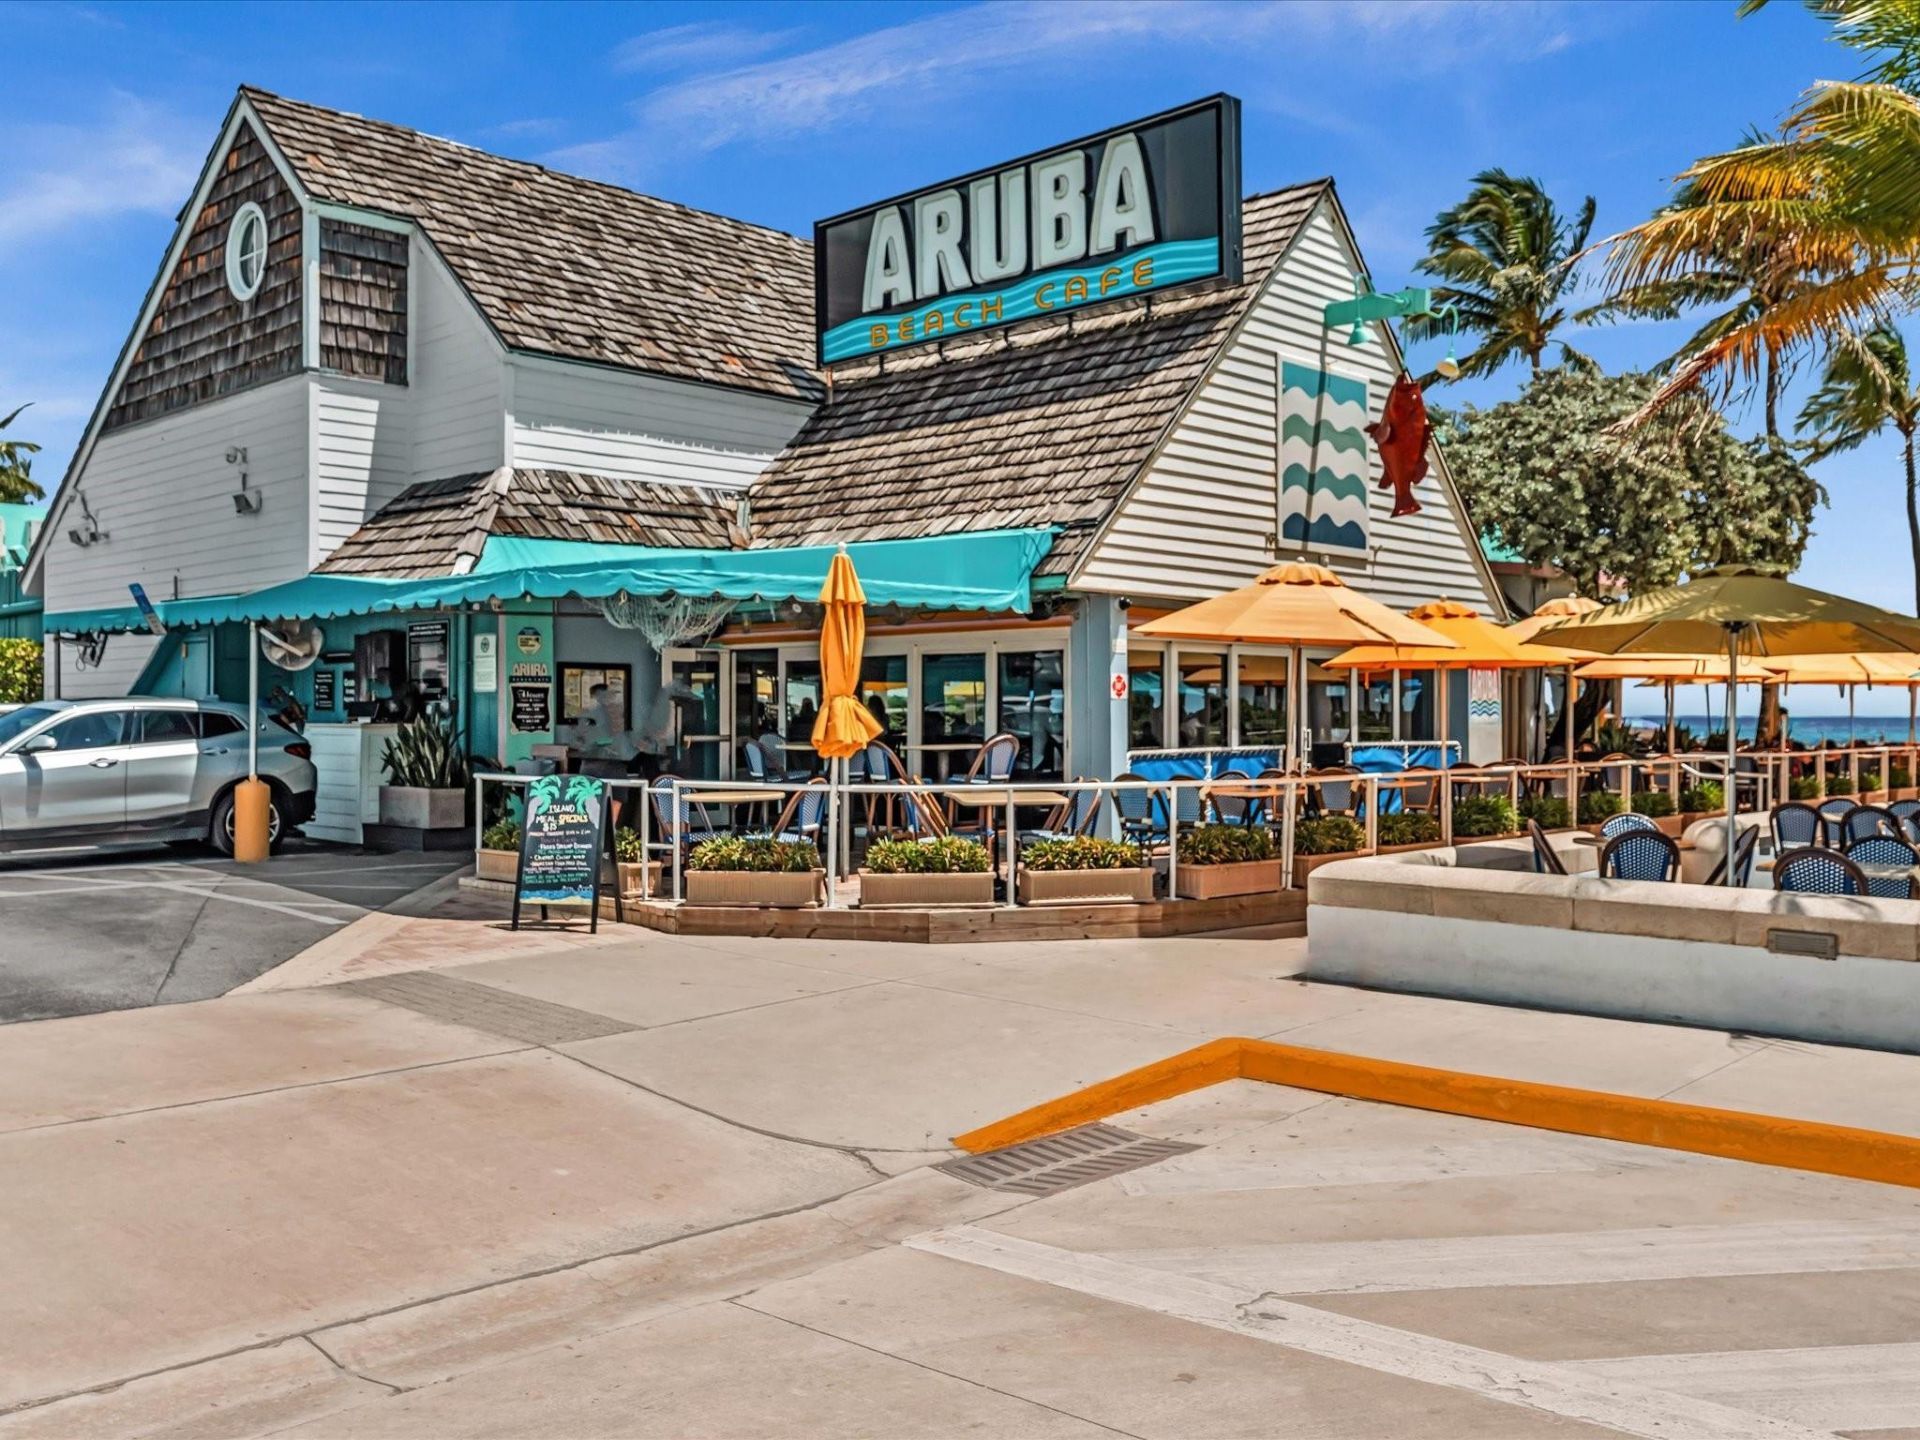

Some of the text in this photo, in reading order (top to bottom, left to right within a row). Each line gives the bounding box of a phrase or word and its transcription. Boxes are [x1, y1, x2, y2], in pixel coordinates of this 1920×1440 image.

[862, 132, 1156, 314] ARUBA
[870, 257, 1153, 348] BEACH CAFE
